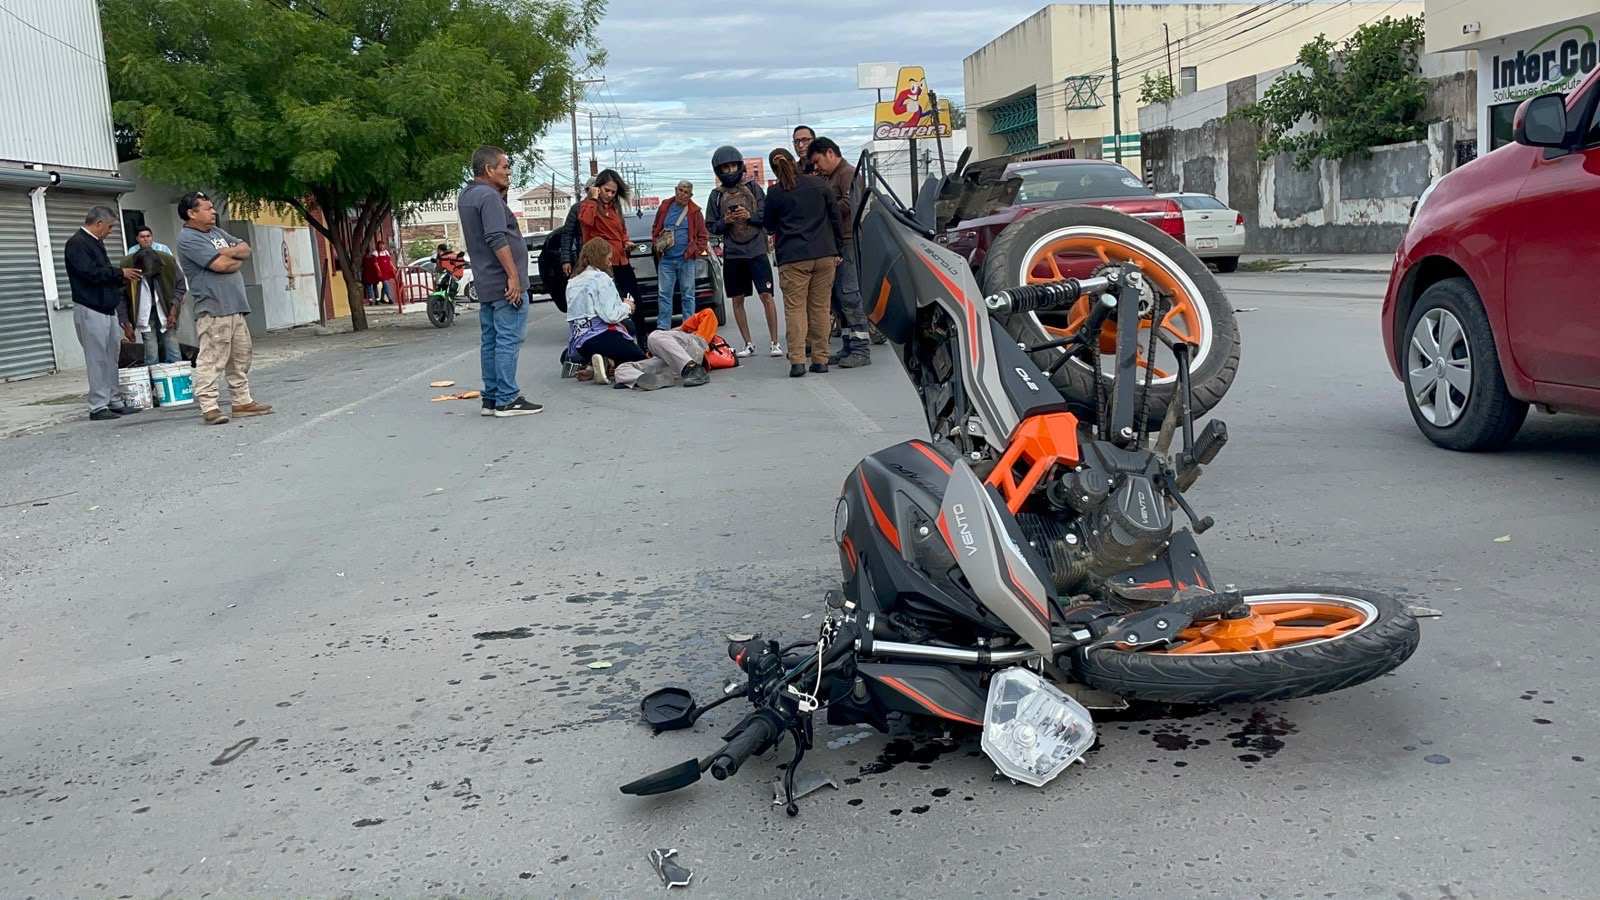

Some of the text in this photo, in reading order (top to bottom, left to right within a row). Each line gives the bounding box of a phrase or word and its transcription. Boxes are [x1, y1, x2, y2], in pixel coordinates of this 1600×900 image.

[1493, 39, 1600, 90] InterCo
[875, 124, 947, 138] Carrera
[1137, 491, 1149, 524] VENTO
[952, 503, 979, 557] VENTO
